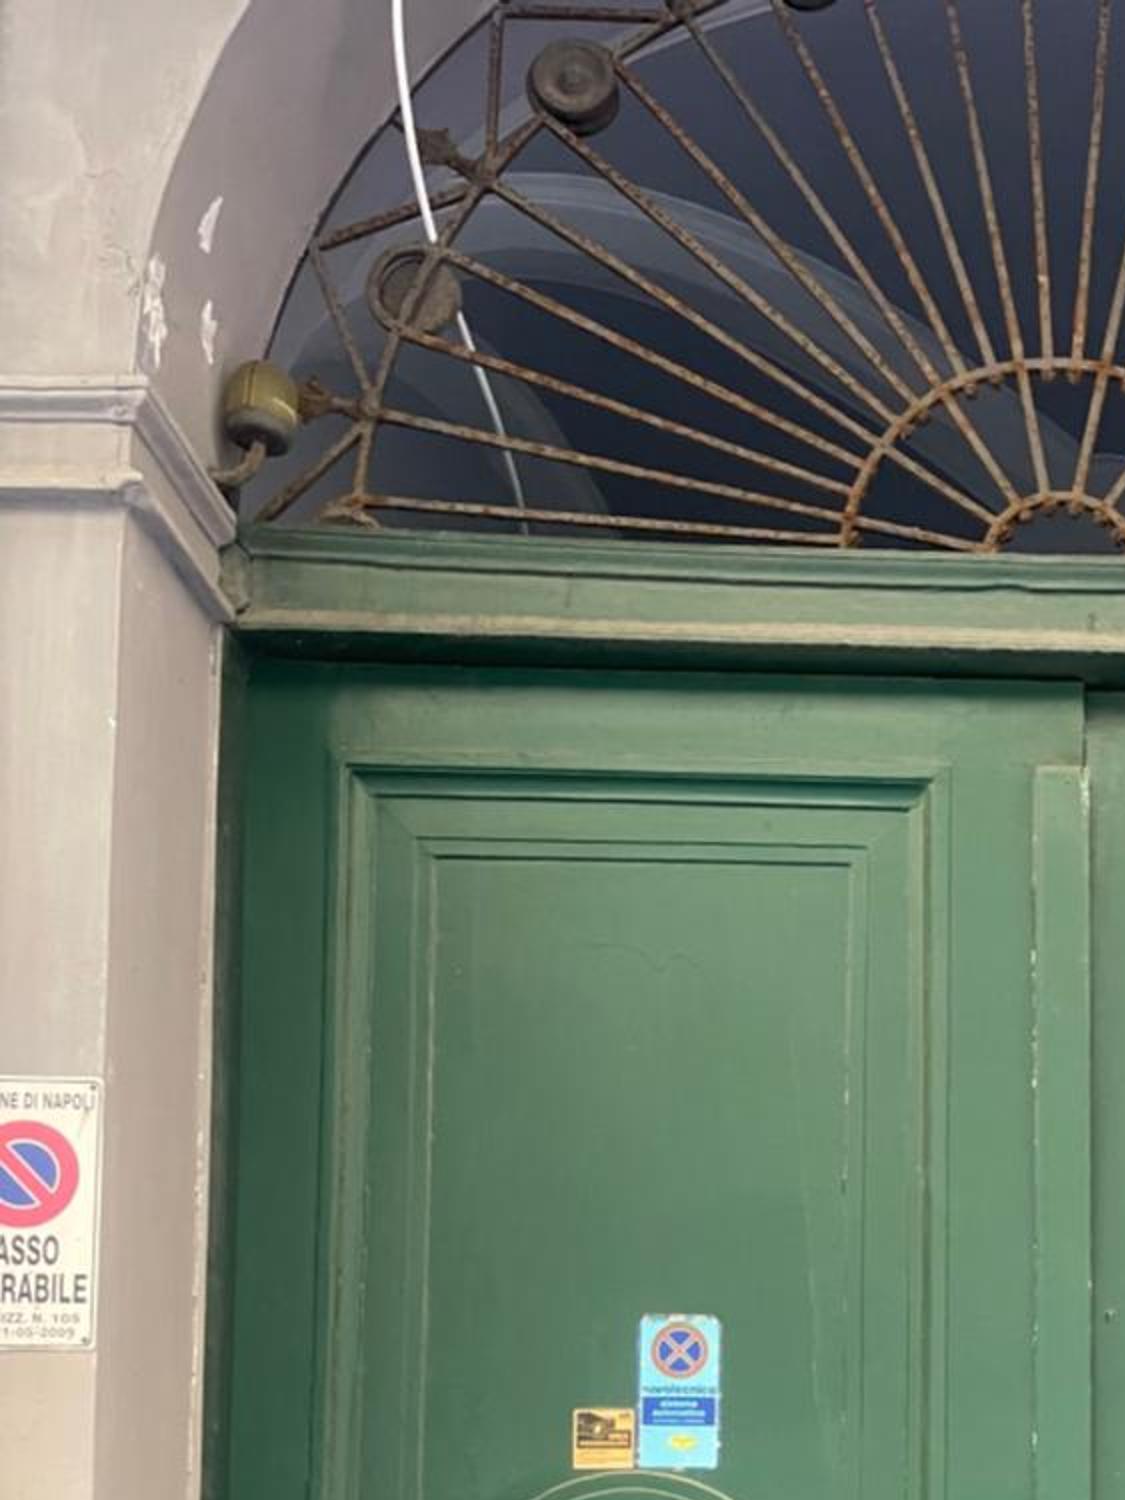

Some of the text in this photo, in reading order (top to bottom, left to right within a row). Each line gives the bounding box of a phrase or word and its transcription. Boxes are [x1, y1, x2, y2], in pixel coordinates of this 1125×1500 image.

[24, 1091, 38, 1110] DI
[43, 1091, 95, 1112] NAPOLI
[1, 1272, 88, 1304] RABILE
